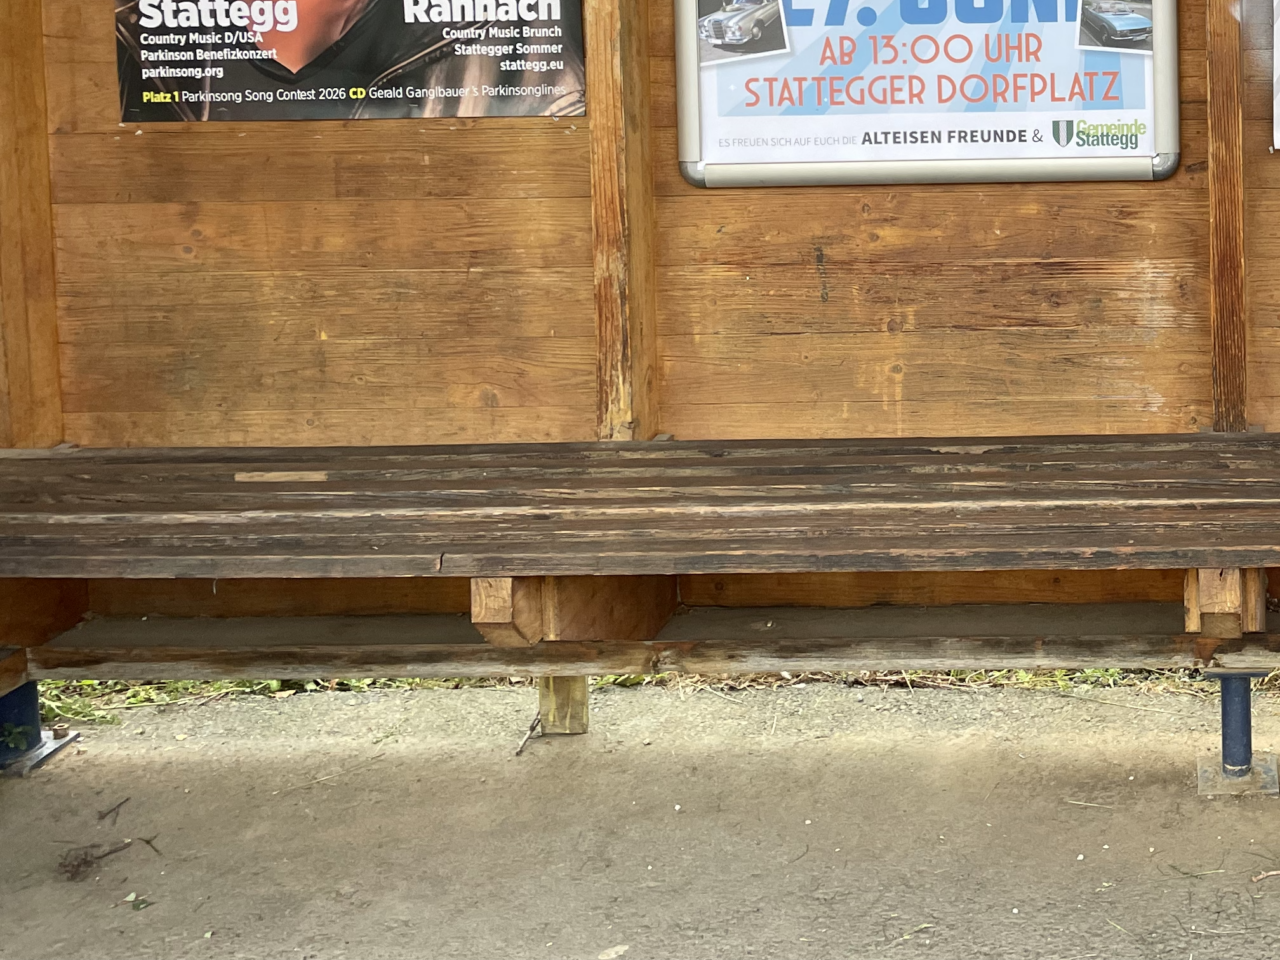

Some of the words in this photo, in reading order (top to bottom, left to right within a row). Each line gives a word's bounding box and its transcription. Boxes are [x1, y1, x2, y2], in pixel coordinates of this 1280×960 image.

[140, 33, 187, 47] Country
[189, 32, 222, 44] Music
[224, 31, 264, 44] D/USA
[442, 27, 487, 40] Country
[489, 26, 521, 38] Music
[522, 26, 562, 38] Brunch
[140, 49, 194, 62] Parkinson
[196, 48, 277, 61] Benefizkonzert
[454, 44, 514, 57] Stattegger
[515, 43, 563, 54] Sommer
[819, 35, 857, 66] AB
[868, 33, 974, 66] 13:00
[984, 32, 1043, 63] UHR
[141, 66, 224, 80] parkinsong.org
[500, 60, 564, 72] stattegg.eu
[142, 91, 172, 103] Platz
[173, 91, 179, 102] 1
[181, 89, 242, 103] Parkinsong
[245, 89, 273, 103] Song
[276, 88, 316, 101] Contest
[318, 88, 346, 100] 2026
[348, 87, 366, 99] CD
[369, 86, 403, 99] Gerald
[481, 83, 567, 97] Parkinsonglines
[744, 75, 926, 108] STATTEGGER
[937, 71, 1120, 104] DORFPLATZ
[1076, 119, 1147, 136] Gemeinde
[718, 138, 731, 147] ES
[732, 137, 769, 147] FREUEN
[770, 137, 792, 146] SICH
[794, 136, 812, 146] AUF
[814, 136, 840, 145] EUCH
[842, 135, 857, 145] DIE
[861, 130, 942, 145] ALTEISEN
[948, 129, 1027, 143] FREUNDE
[1032, 128, 1044, 142] &
[1076, 131, 1139, 150] Stattegg
